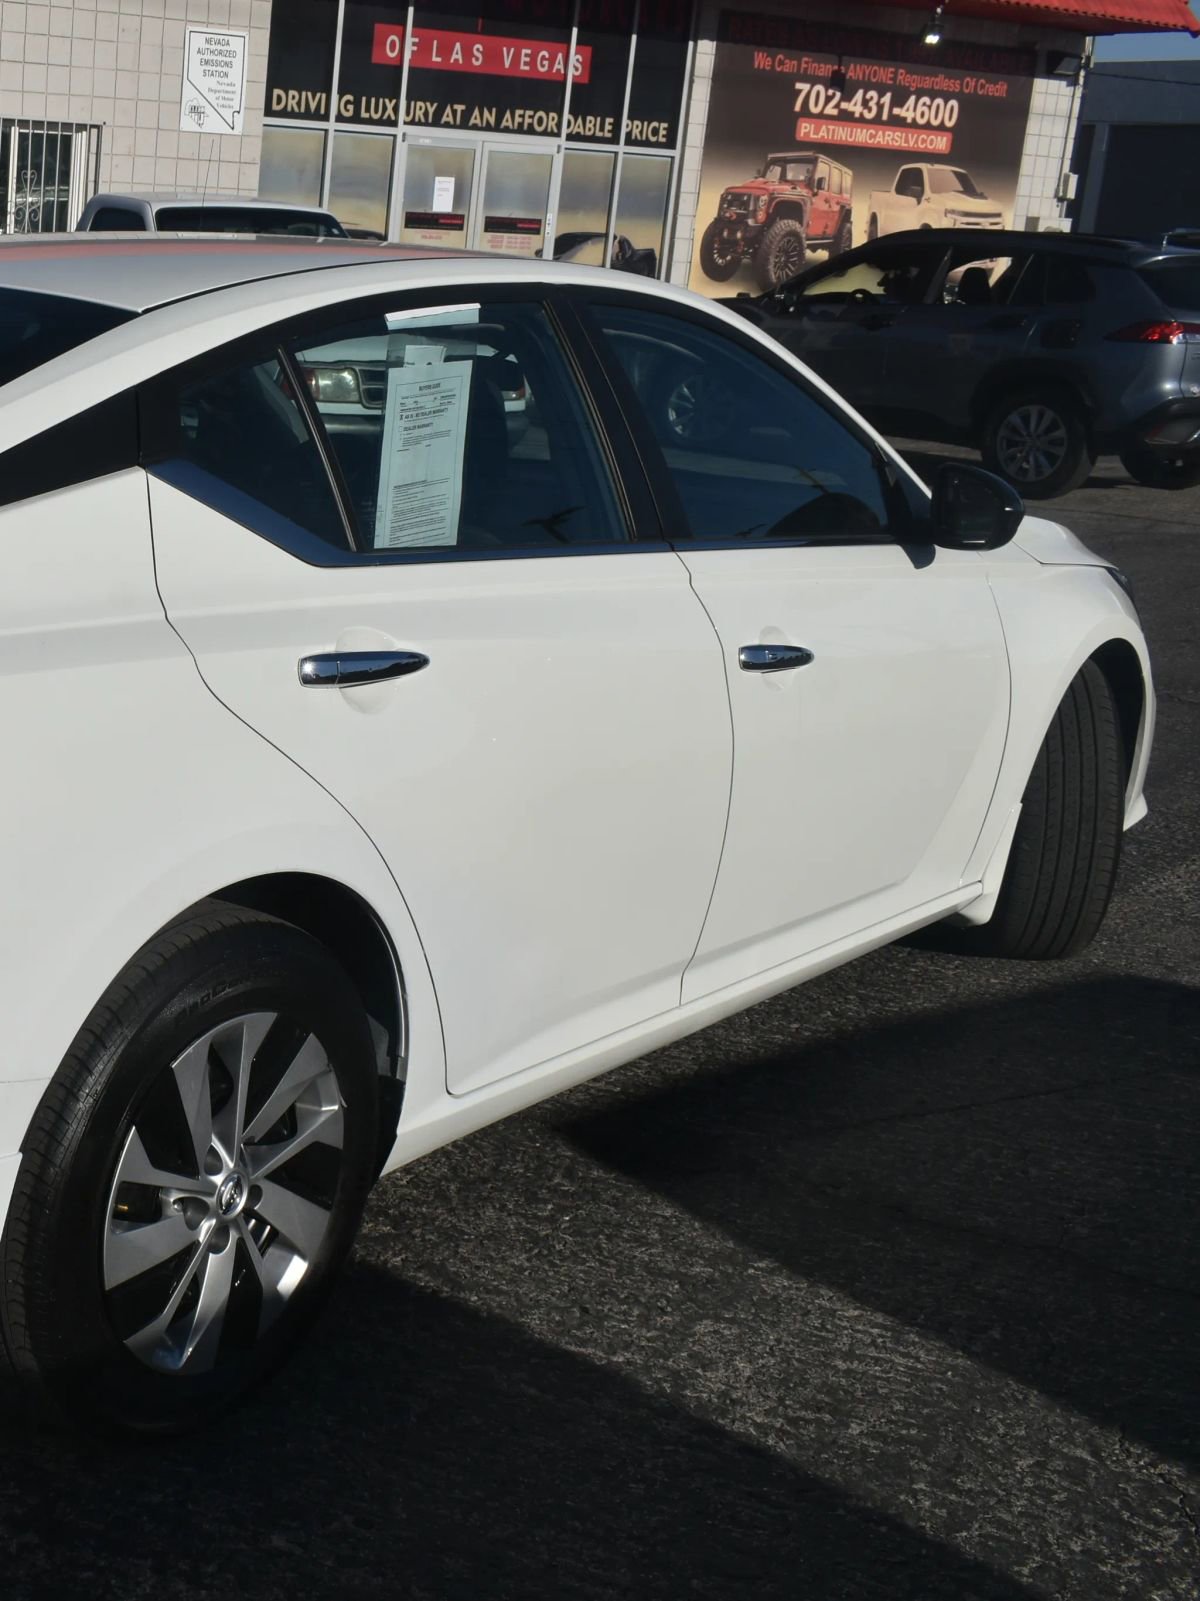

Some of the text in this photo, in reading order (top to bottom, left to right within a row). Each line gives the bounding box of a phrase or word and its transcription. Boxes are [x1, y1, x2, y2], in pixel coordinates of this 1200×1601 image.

[197, 48, 237, 58] AUTHORIZED
[205, 37, 230, 47] NEVADA
[200, 58, 233, 69] EMISSIONS
[432, 40, 483, 66] LAS
[502, 47, 583, 76] VEGAS
[202, 69, 229, 79] STATION
[754, 51, 1008, 97] We Can Finan ANYONE Reguardless Of Credit
[794, 82, 958, 128] 702-431-4600
[360, 96, 438, 123] LUXURY
[441, 104, 466, 126] AT
[468, 106, 496, 128] AN
[500, 109, 614, 138] AFFORDABLE
[624, 120, 668, 142] PRICE
[800, 123, 947, 150] PLATINUMCARSLV.COM
